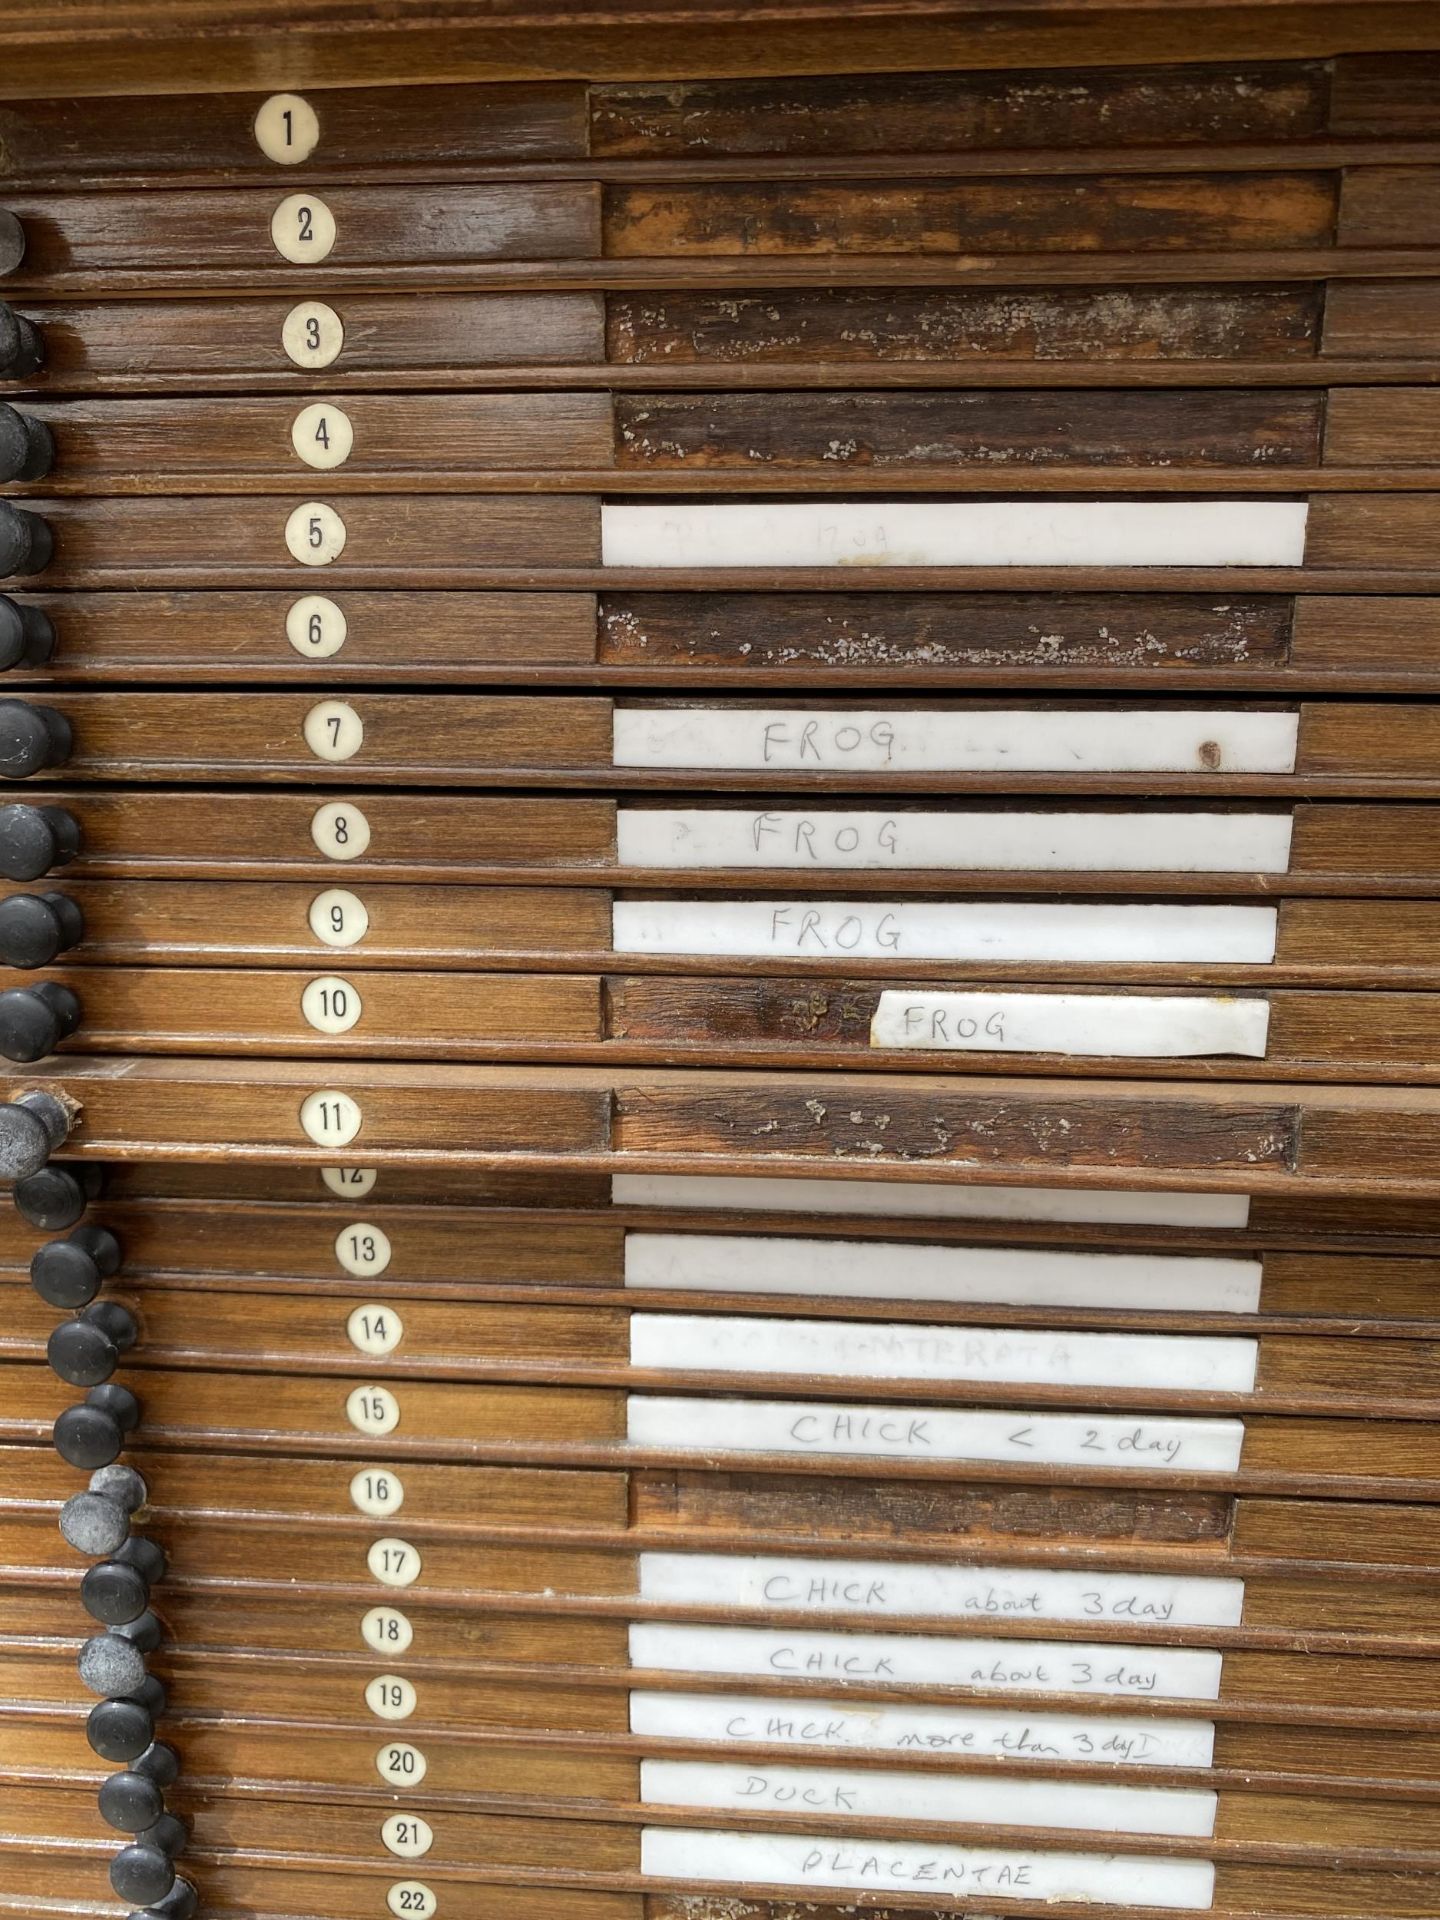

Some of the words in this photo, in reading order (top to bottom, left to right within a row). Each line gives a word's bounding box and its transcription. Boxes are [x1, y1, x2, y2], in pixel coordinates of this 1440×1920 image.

[282, 110, 292, 146] 1
[297, 207, 313, 241] 2
[306, 317, 321, 350] 3
[315, 417, 330, 450] 4
[309, 518, 323, 548] 5
[308, 614, 322, 644] 6
[327, 717, 341, 748] 7
[763, 720, 895, 762] FROG
[335, 816, 348, 844] 8
[751, 812, 898, 860] FROG
[330, 905, 344, 933] 9
[771, 907, 902, 952] FROG
[320, 989, 347, 1017] 10
[902, 1005, 1006, 1043] FROG
[319, 1102, 341, 1131] 11
[350, 1236, 376, 1262] 13
[362, 1316, 386, 1340] 14
[361, 1397, 385, 1421] 15
[789, 1414, 931, 1445] CHICK
[1007, 1427, 1035, 1448] <
[1079, 1429, 1106, 1451] 2
[1116, 1427, 1182, 1463] day
[365, 1477, 389, 1501] 16
[383, 1550, 406, 1573] 17
[763, 1575, 886, 1604] CHICK
[964, 1589, 1041, 1612] about
[1081, 1592, 1104, 1615] 3
[1111, 1595, 1174, 1620] day
[377, 1617, 399, 1641] 18
[769, 1647, 895, 1675] CHICK
[969, 1663, 1051, 1684] about
[1071, 1662, 1093, 1685] 3
[1103, 1666, 1157, 1691] day
[380, 1684, 402, 1707] 19
[725, 1716, 845, 1739] CHICK
[896, 1732, 975, 1748] more
[992, 1731, 1061, 1755] than
[1072, 1733, 1095, 1754] 3
[1100, 1734, 1135, 1760] day
[389, 1749, 414, 1774] 20
[734, 1774, 857, 1810] DUCK
[396, 1822, 418, 1844] 21
[801, 1849, 1033, 1886] PLACENTAE
[400, 1890, 425, 1911] 22
